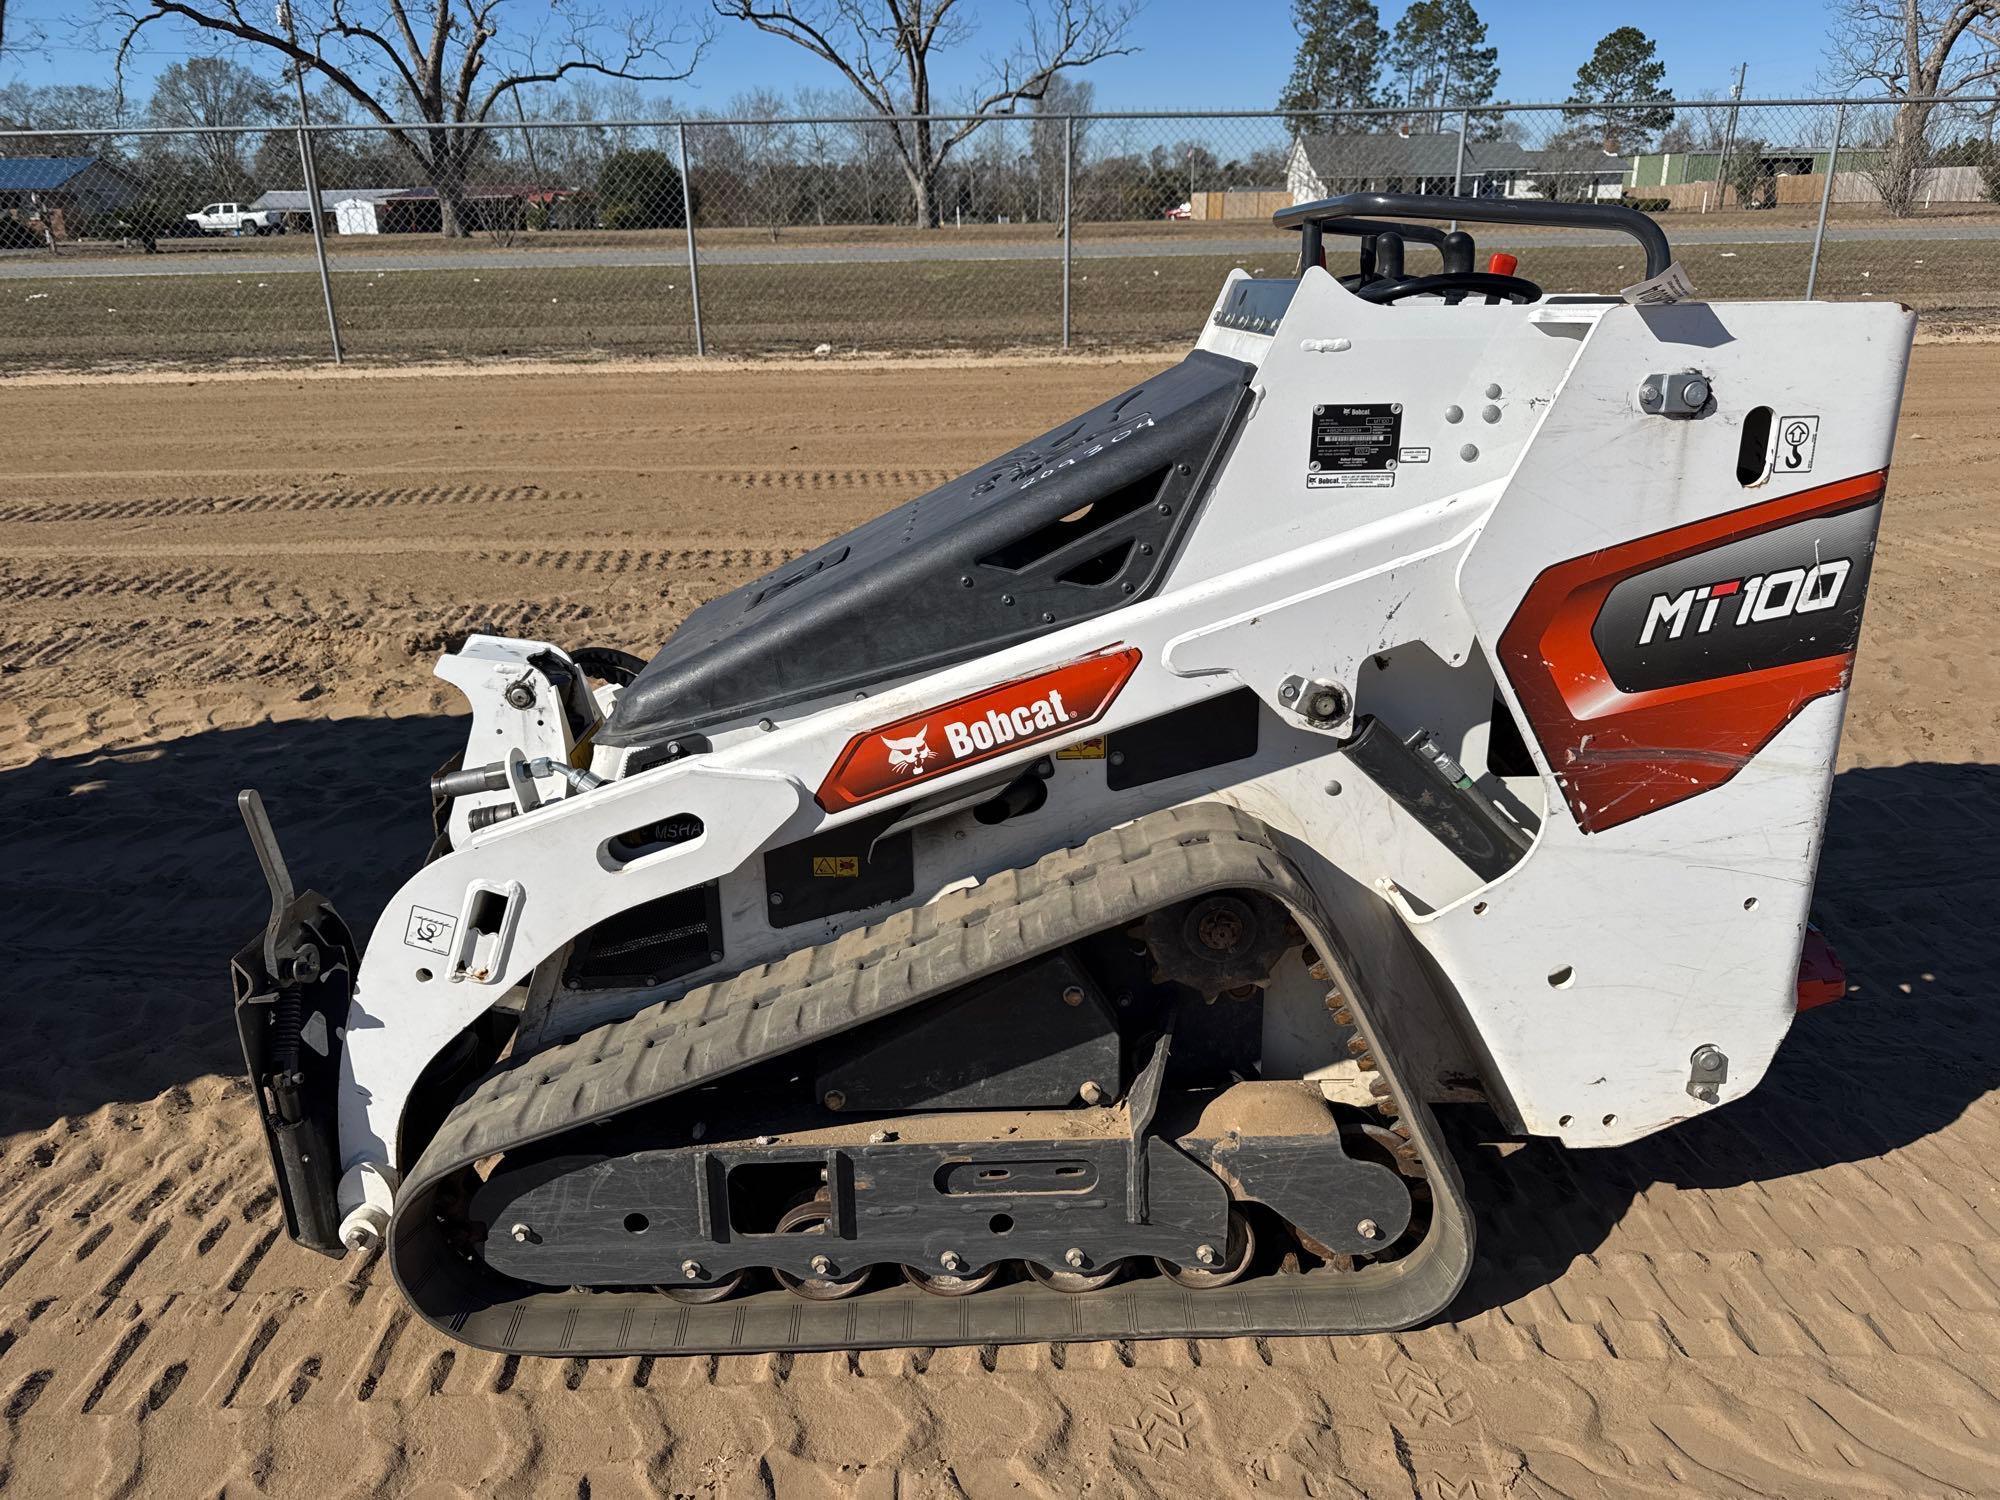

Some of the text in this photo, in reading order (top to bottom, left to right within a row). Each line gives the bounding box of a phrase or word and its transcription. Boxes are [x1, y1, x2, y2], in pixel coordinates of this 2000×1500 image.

[1638, 559, 1852, 646] MT100
[944, 688, 1070, 760] Bobcat
[655, 822, 702, 839] MSHA
